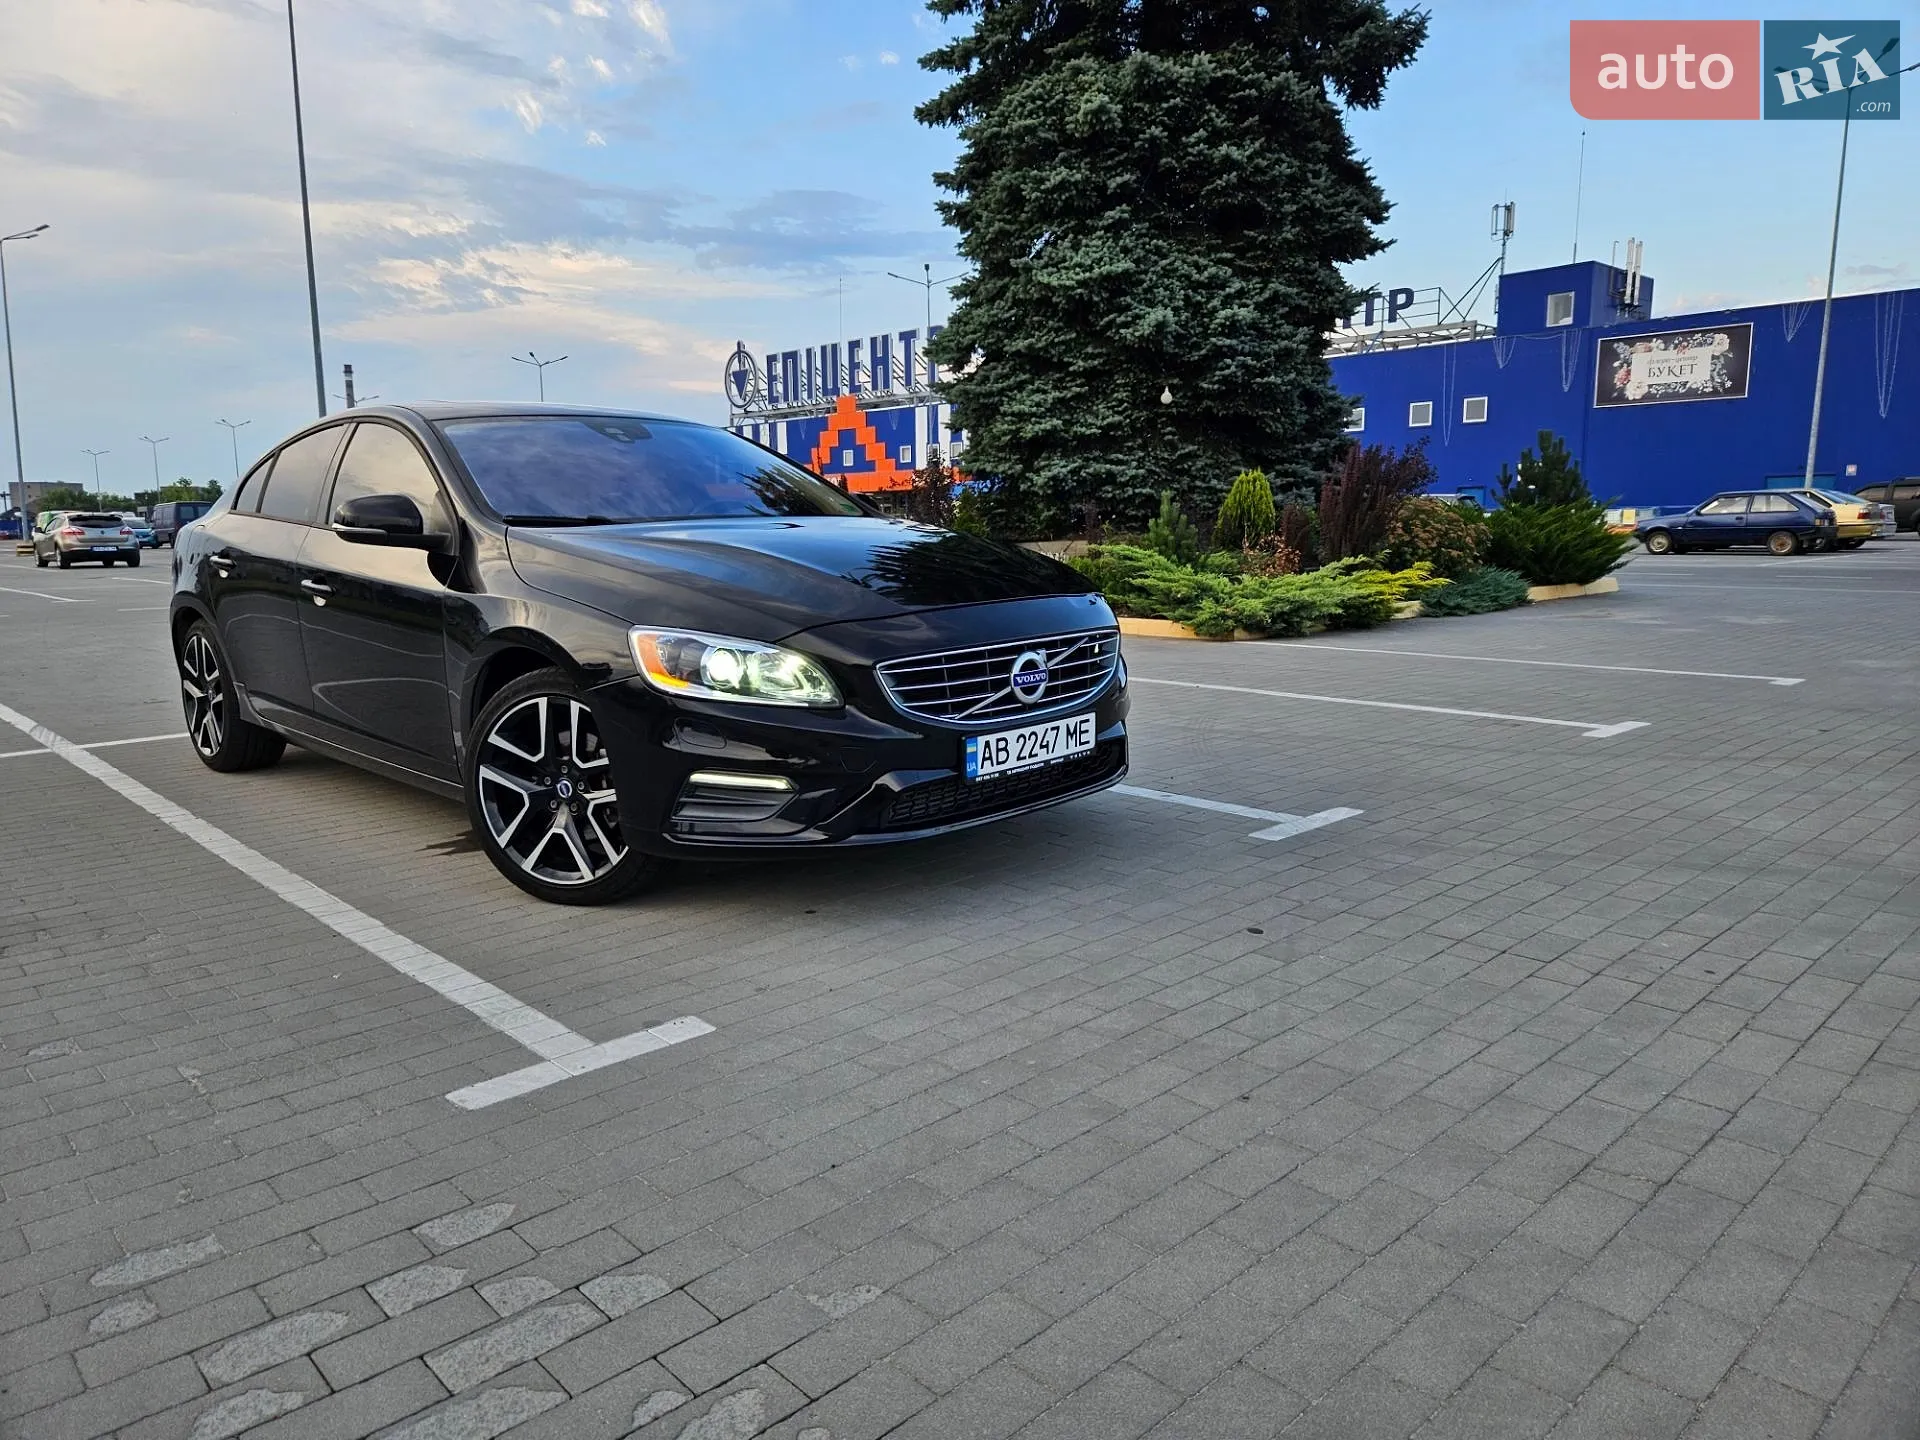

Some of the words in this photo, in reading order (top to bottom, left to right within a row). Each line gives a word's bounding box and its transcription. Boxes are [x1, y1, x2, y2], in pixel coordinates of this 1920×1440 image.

[1648, 363, 1697, 378] БУКЕТ
[1015, 672, 1046, 683] VOLVO
[980, 736, 1010, 769] AB
[1016, 725, 1060, 761] 2247
[1066, 718, 1090, 750] ME
[966, 762, 977, 772] UA
